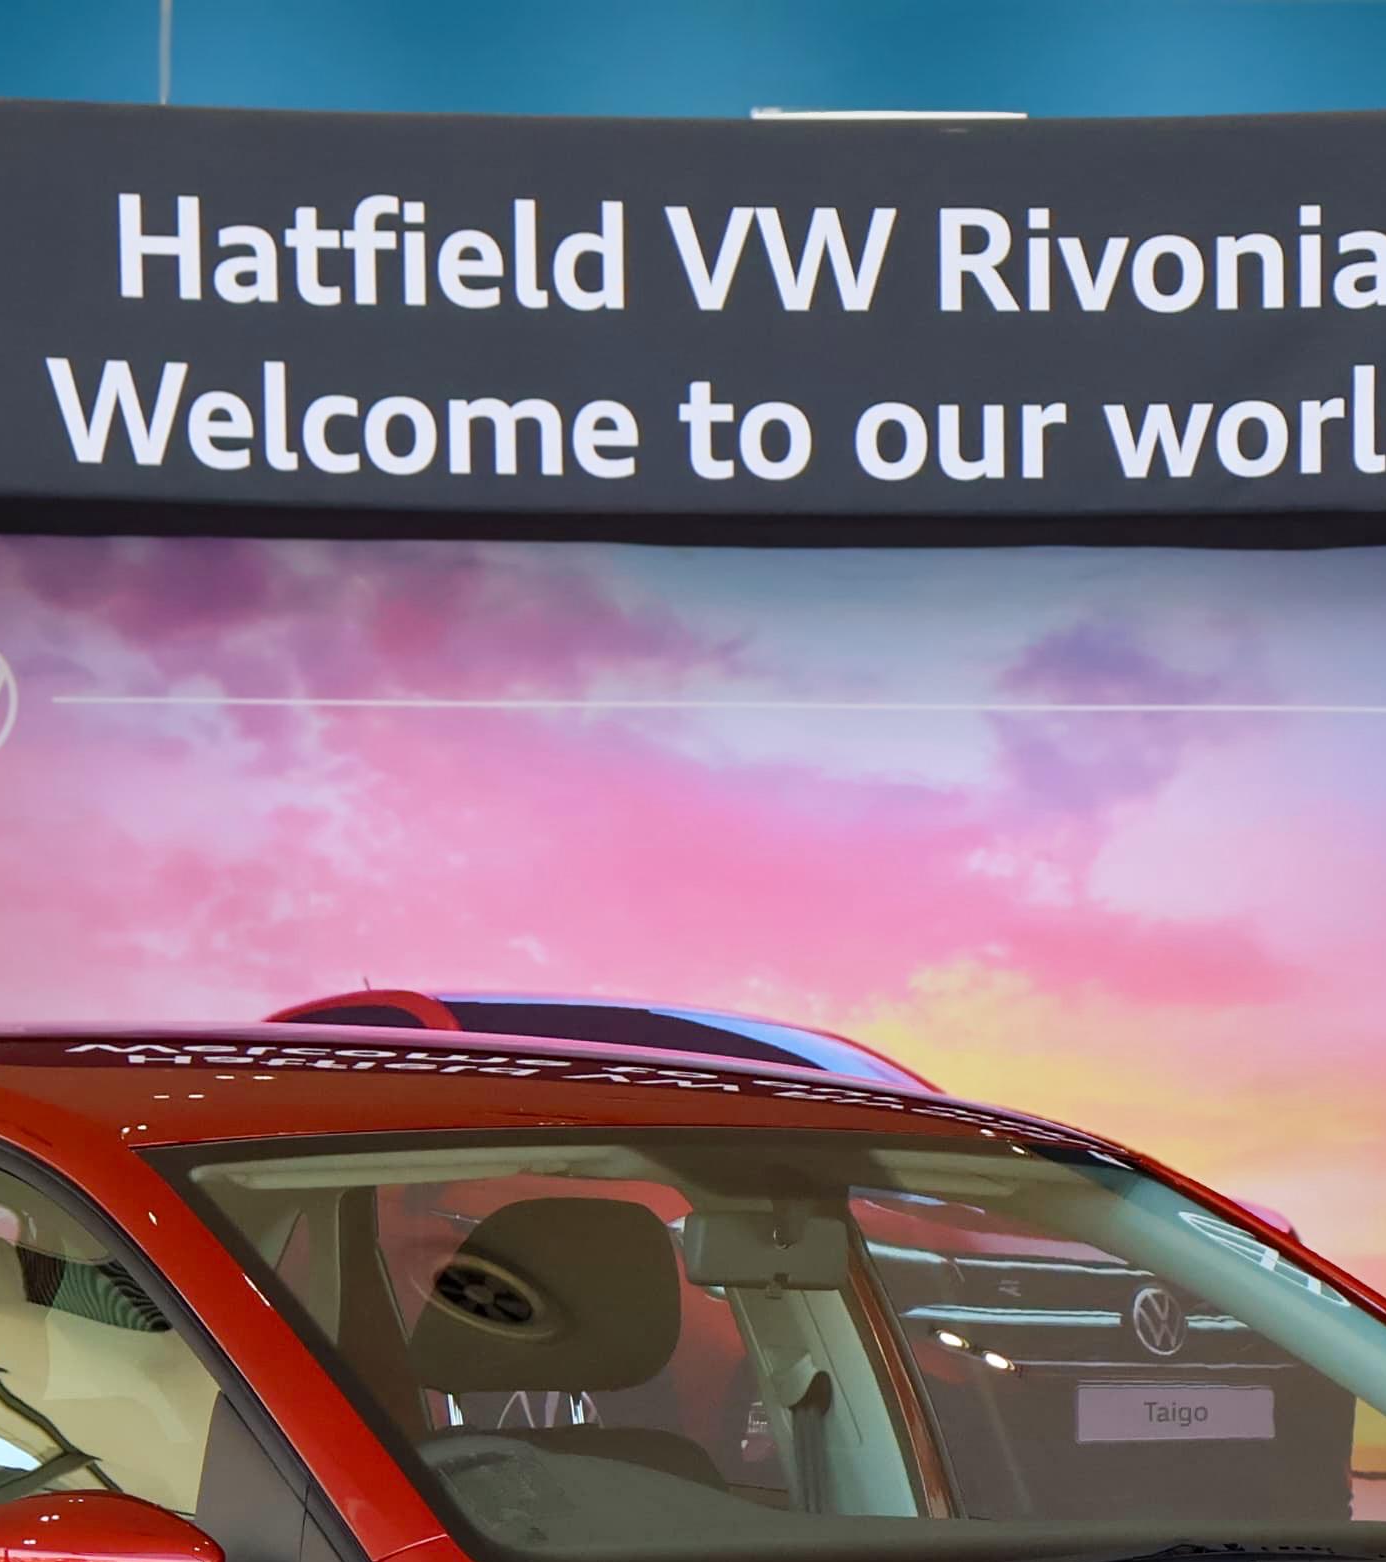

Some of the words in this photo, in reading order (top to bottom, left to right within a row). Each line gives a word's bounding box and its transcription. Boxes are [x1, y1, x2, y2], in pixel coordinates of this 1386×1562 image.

[118, 192, 625, 311] Hatfield
[665, 206, 897, 311] VW
[46, 357, 639, 479] Welcome
[679, 381, 812, 481] to
[855, 402, 1067, 481] our
[1143, 1400, 1209, 1428] Taigo
